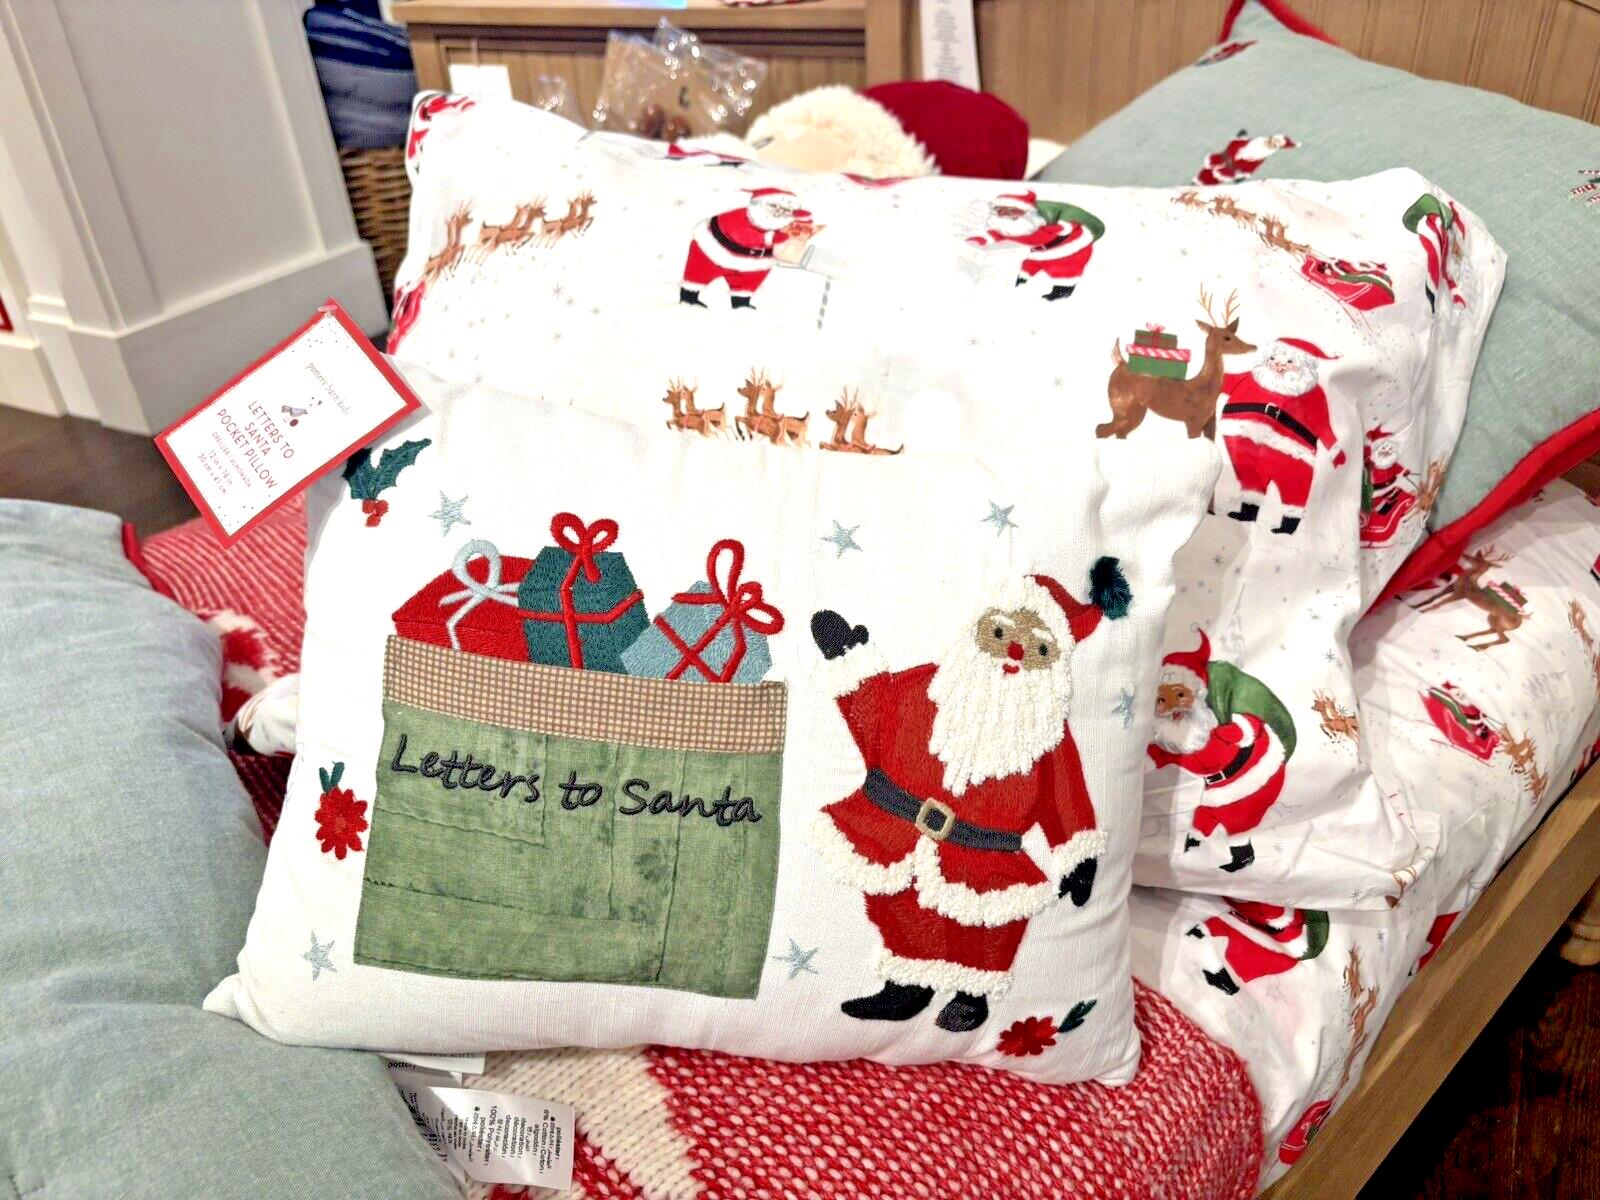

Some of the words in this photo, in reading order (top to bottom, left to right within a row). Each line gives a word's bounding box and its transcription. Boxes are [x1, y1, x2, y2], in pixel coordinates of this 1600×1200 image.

[216, 408, 250, 449] POCKET
[243, 448, 279, 489] PILLOW
[244, 422, 272, 457] SANTA
[248, 400, 284, 444] LETTERS
[279, 441, 295, 459] TO
[390, 733, 541, 803] Letters
[558, 770, 604, 811] to
[619, 778, 763, 827] Santa
[488, 1105, 498, 1126] 100%
[484, 1127, 494, 1163] Polyester
